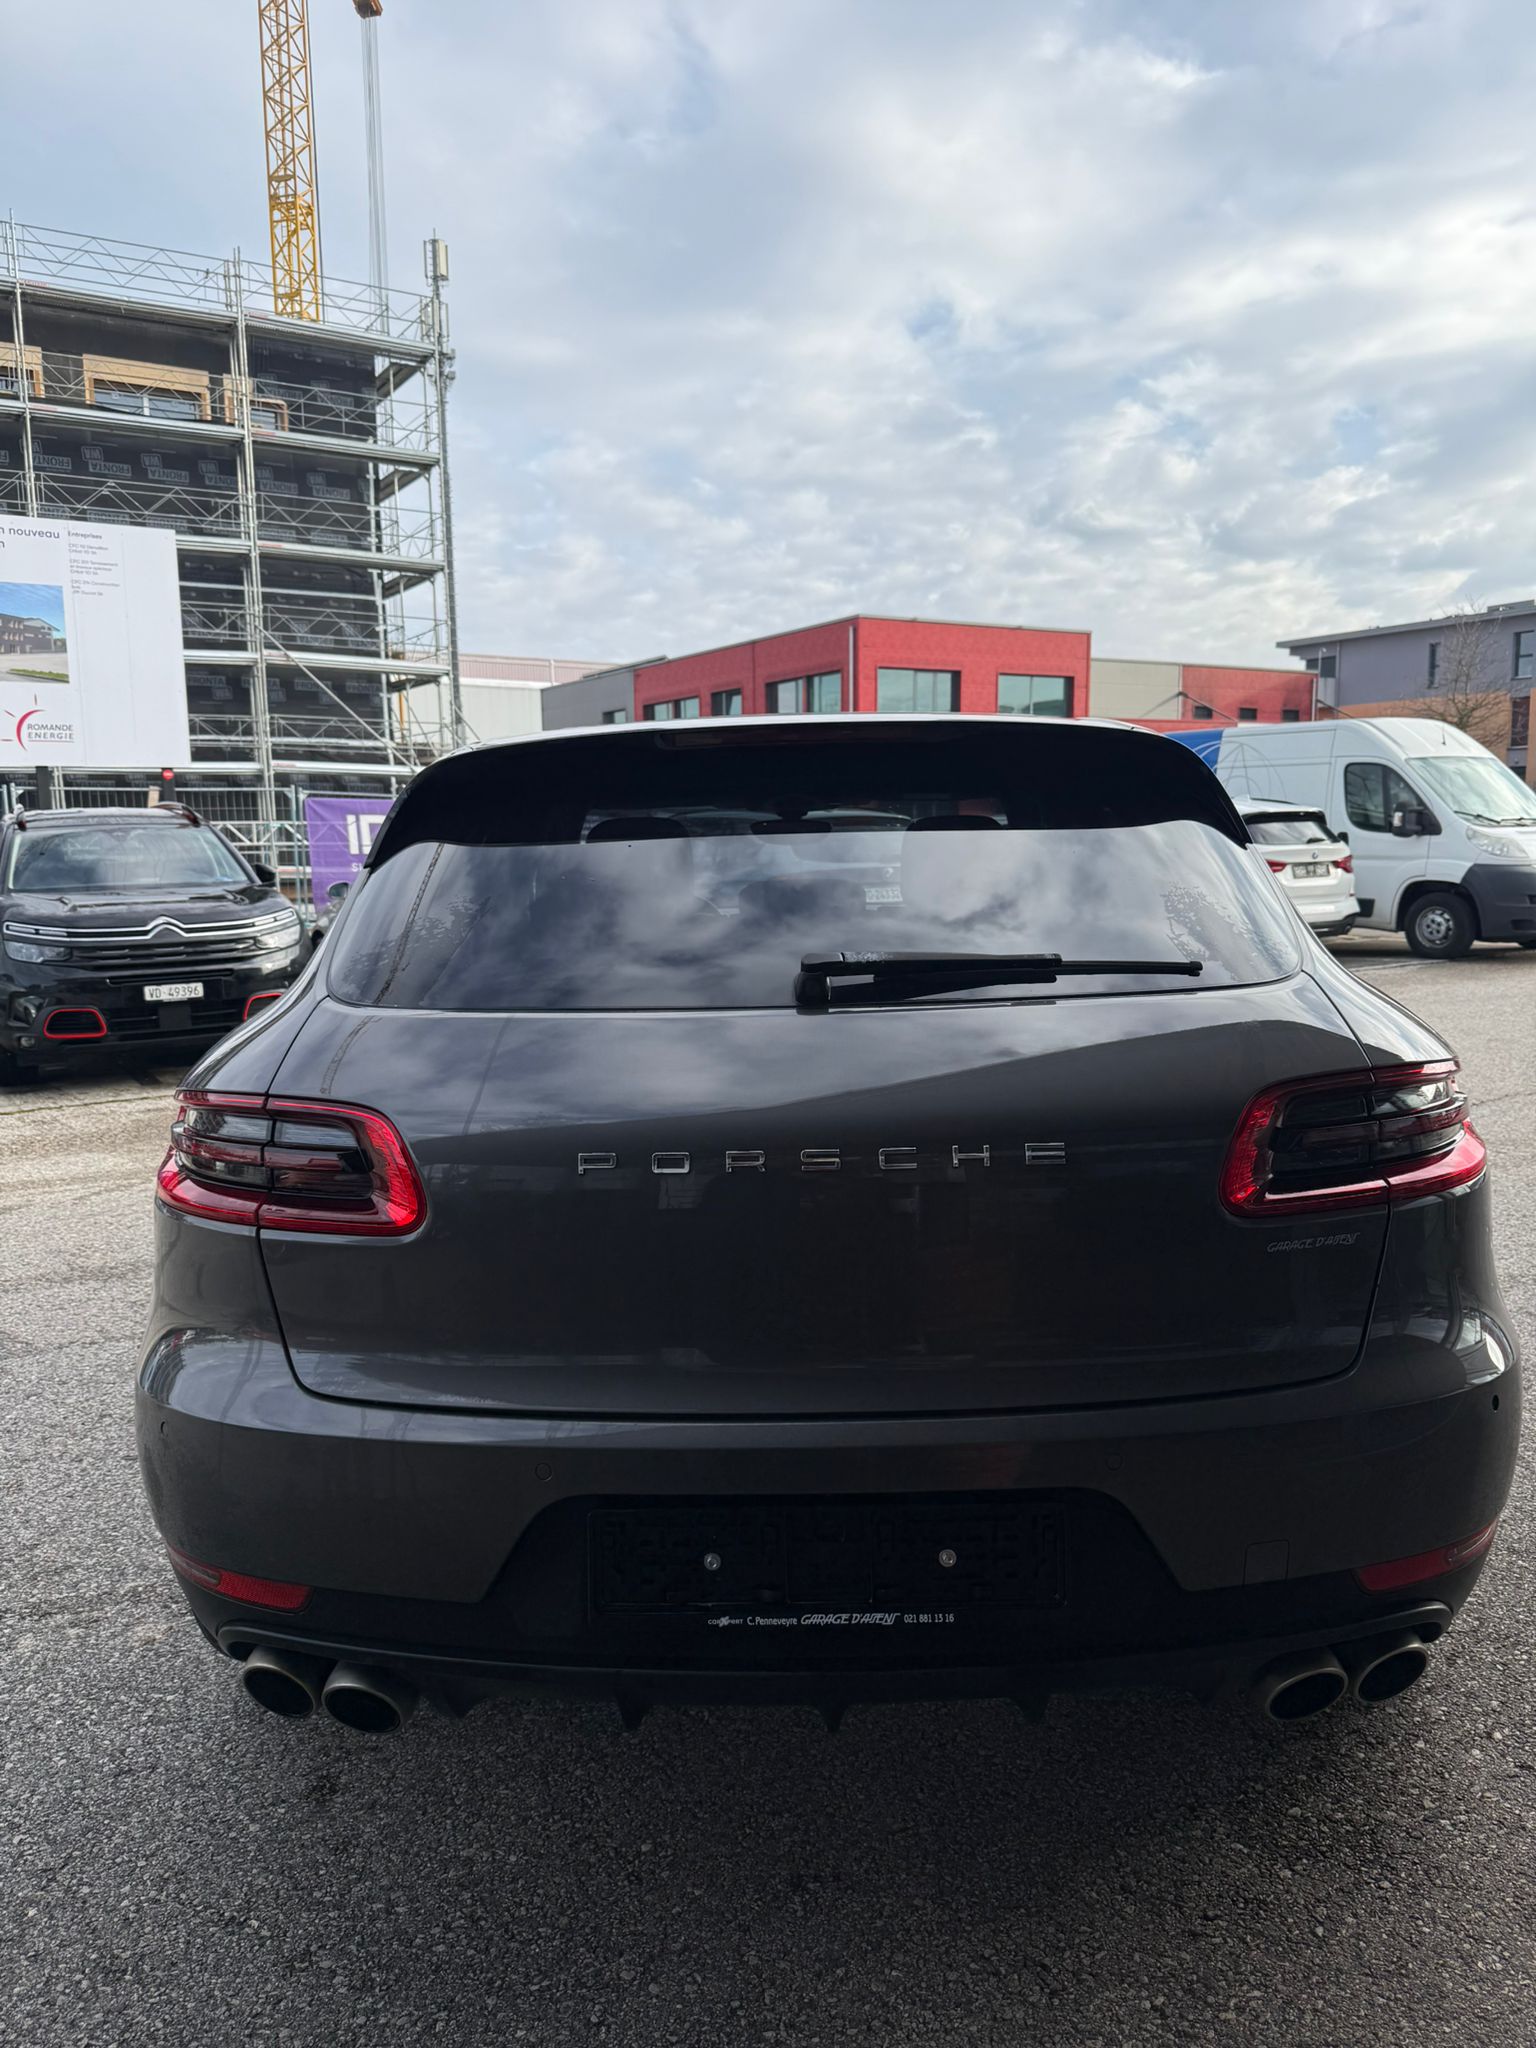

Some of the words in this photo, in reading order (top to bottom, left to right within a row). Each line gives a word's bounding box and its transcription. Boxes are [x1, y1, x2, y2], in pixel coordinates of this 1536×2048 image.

[9, 527, 60, 539] nouveau
[27, 723, 73, 732] ROMANDE
[28, 731, 74, 740] ENERGIE
[148, 988, 162, 999] VD
[168, 985, 201, 997] 49396
[578, 1142, 1067, 1175] PORSCHE
[1267, 1238, 1315, 1252] GARAGE
[755, 1616, 798, 1627] Penneveyre
[801, 1614, 850, 1626] GARAGE
[904, 1614, 917, 1623] 021
[919, 1613, 932, 1623] 881
[946, 1613, 955, 1623] 16
